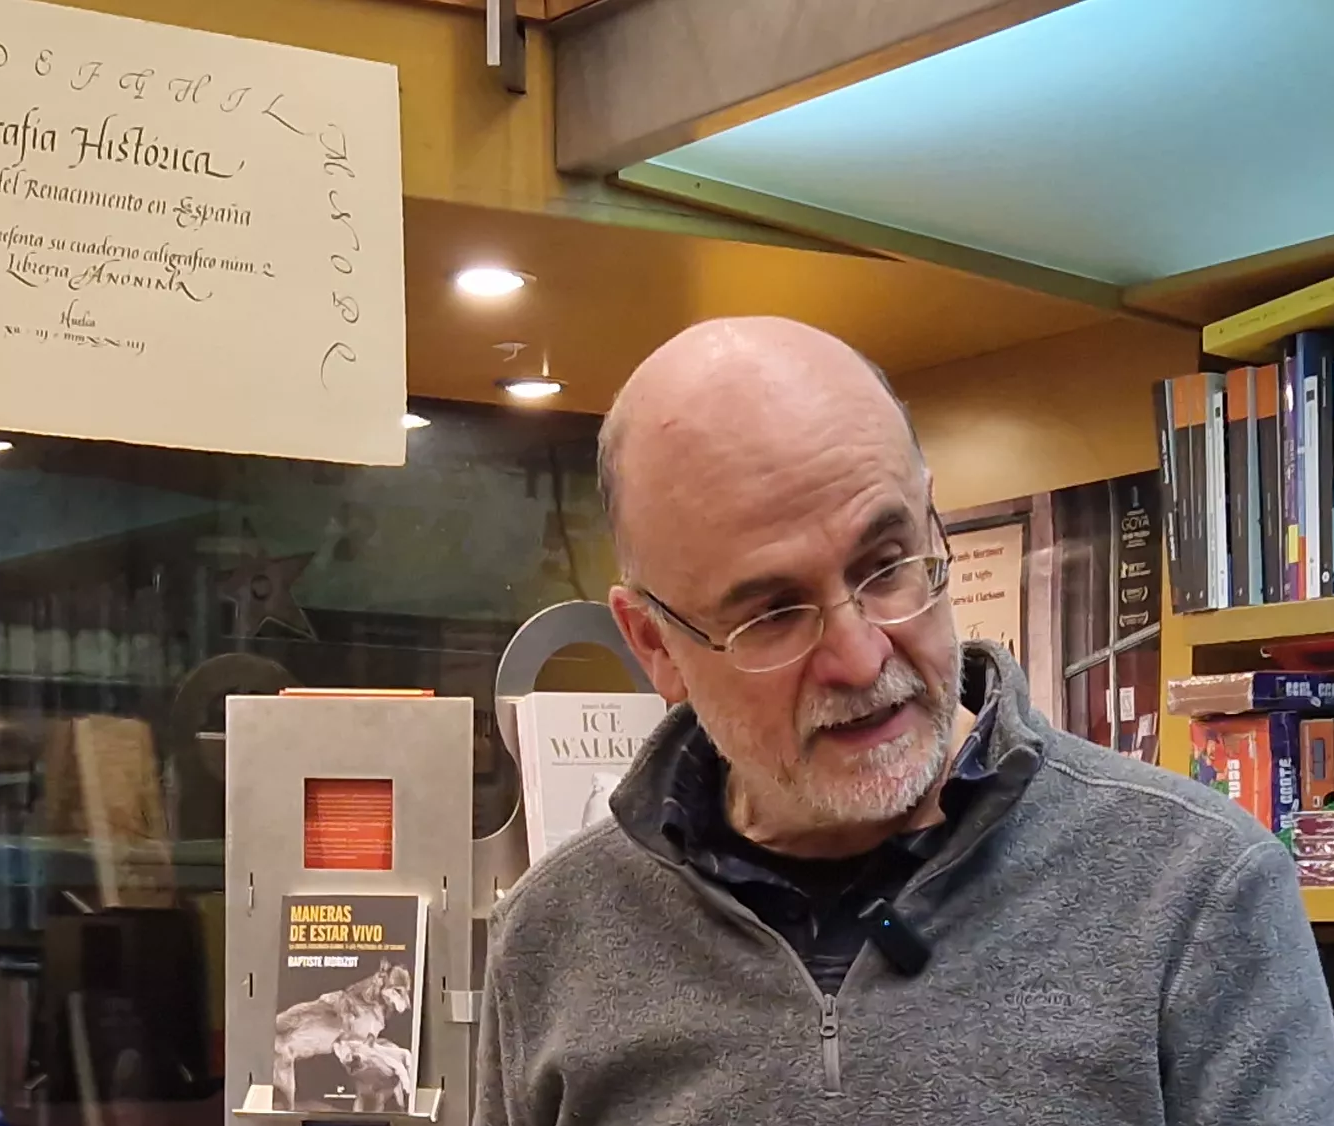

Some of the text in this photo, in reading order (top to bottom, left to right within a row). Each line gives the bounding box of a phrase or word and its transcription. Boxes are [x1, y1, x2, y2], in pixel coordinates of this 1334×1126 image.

[24, 179, 142, 212] Renacimiento
[148, 199, 166, 214] en
[49, 237, 66, 250] su
[70, 235, 139, 259] cuaderno
[582, 712, 624, 734] ICE
[290, 905, 352, 923] MANERAS
[289, 924, 382, 942] DE ESTAR VIVO
